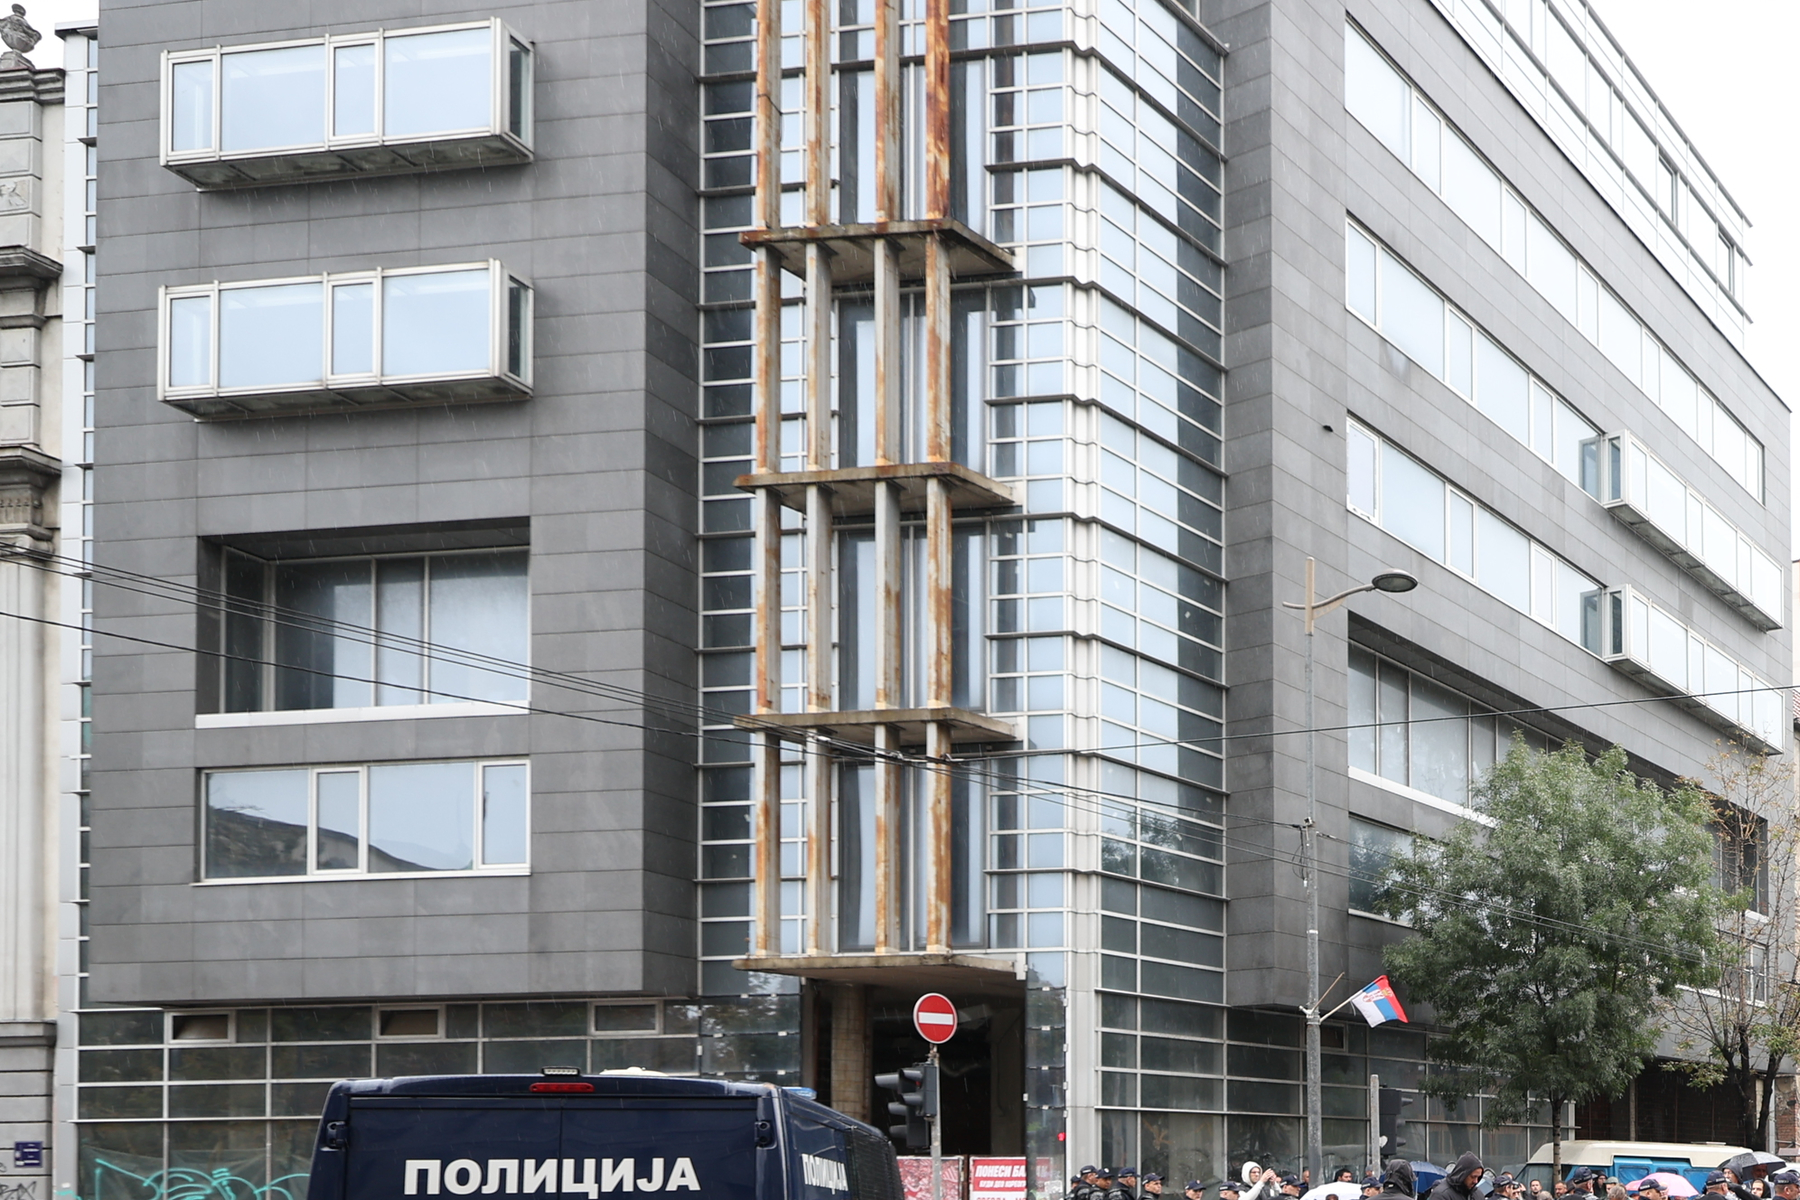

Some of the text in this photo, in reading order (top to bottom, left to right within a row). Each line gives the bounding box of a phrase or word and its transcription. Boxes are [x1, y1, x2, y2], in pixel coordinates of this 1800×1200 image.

[403, 1157, 701, 1200] ПОЛИЦИЈА
[801, 1153, 849, 1195] ПОЛИЦИЈА
[975, 1165, 1013, 1178] ПОНЕСИ
